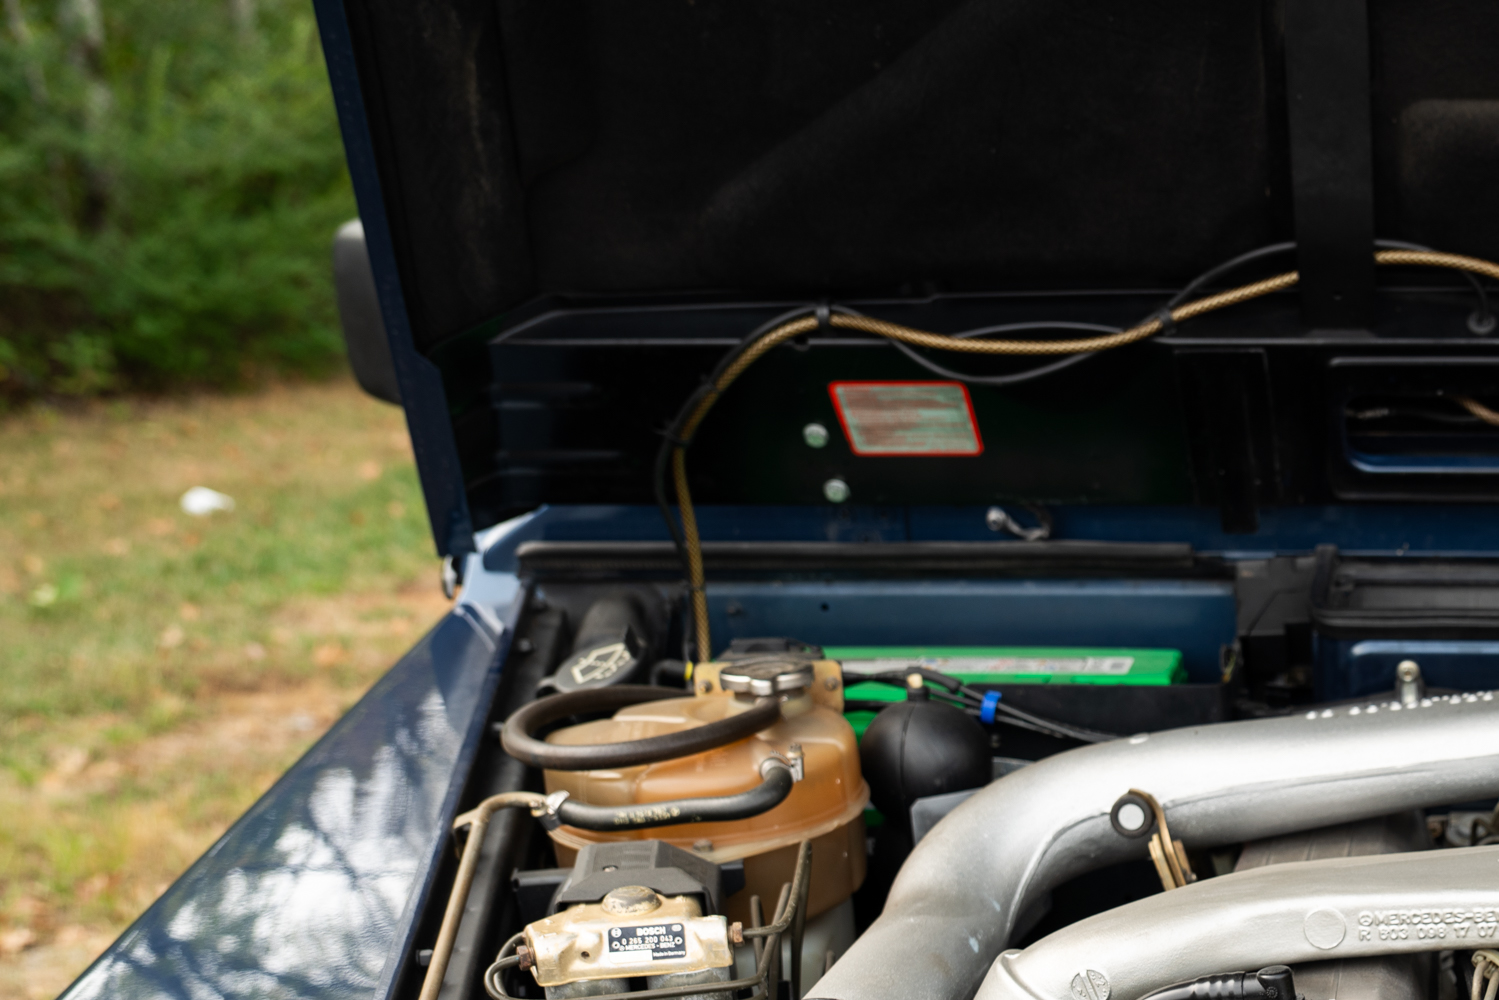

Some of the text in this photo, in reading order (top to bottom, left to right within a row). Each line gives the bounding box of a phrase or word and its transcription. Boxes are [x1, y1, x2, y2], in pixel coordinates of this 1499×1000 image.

[636, 926, 666, 936] BOSCH
[1358, 926, 1371, 941] R
[1453, 922, 1470, 938] 17
